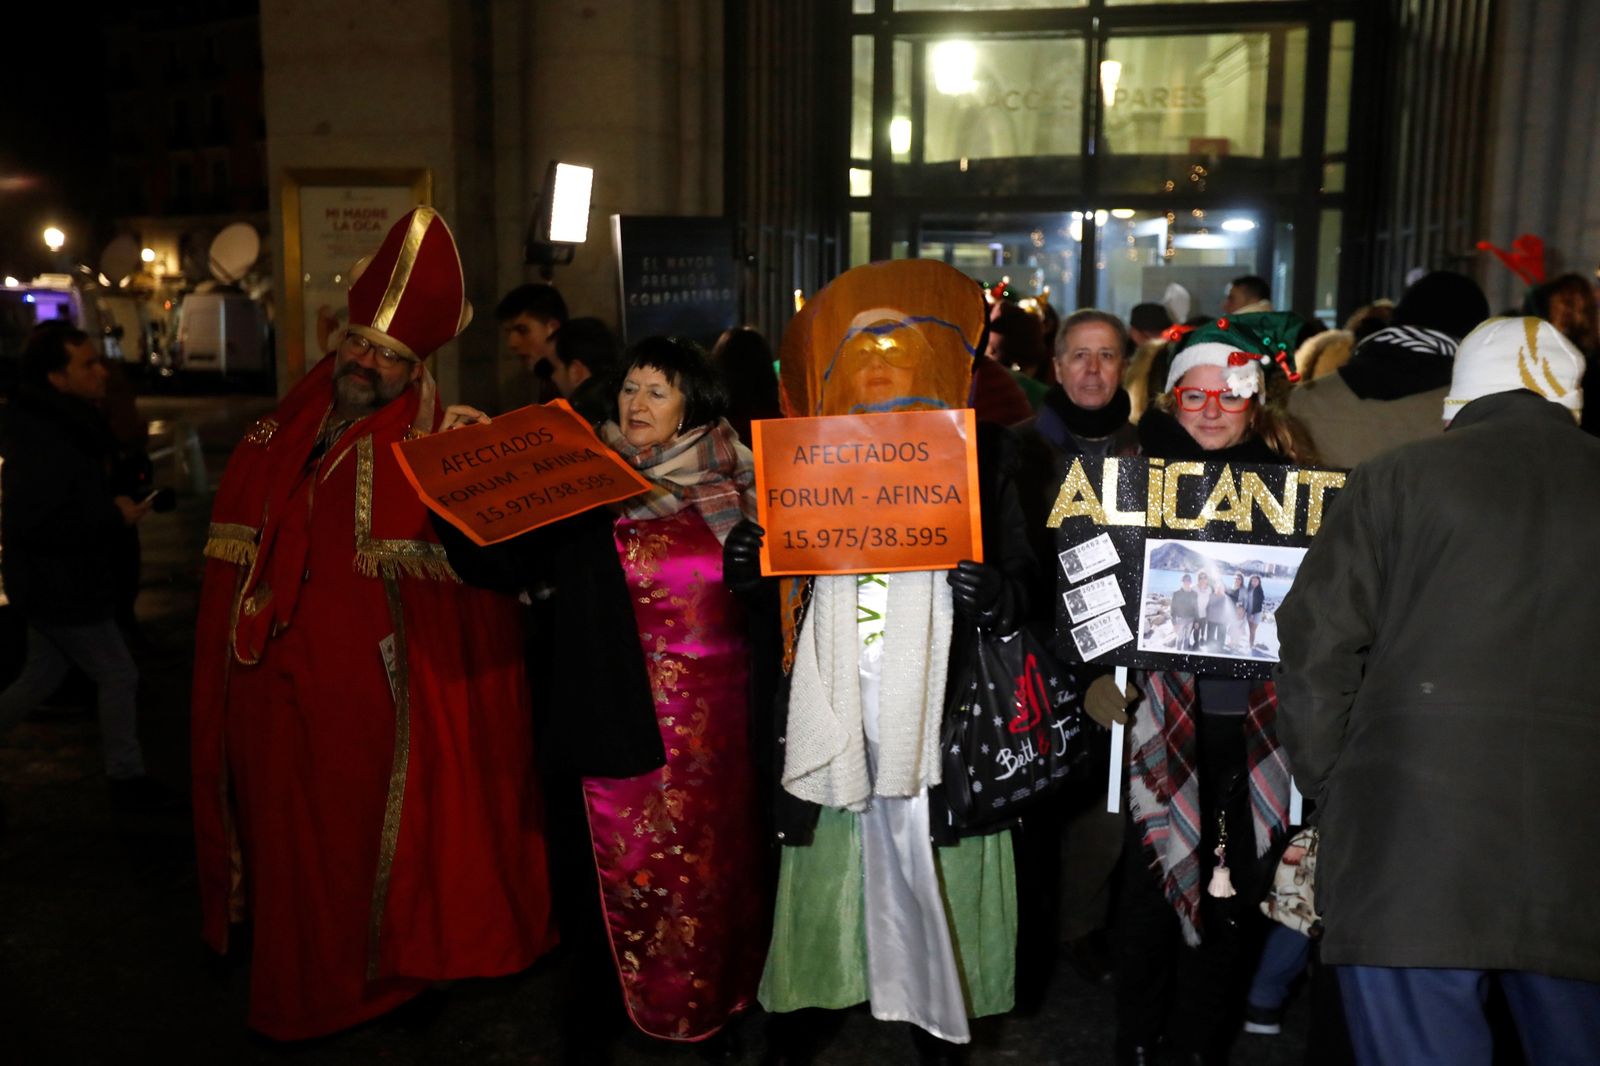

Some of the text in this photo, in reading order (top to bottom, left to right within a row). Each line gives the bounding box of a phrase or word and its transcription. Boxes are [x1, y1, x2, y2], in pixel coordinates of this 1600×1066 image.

[441, 427, 554, 475] AFECTADOS
[793, 442, 929, 465] AFECTADOS
[438, 471, 519, 507] FORUM
[532, 447, 601, 475] AFINSA
[476, 473, 615, 525] 15.975/38.595
[768, 487, 854, 508] FORUM
[876, 484, 962, 506] AFINSA
[783, 526, 948, 550] 15.975/38.595
